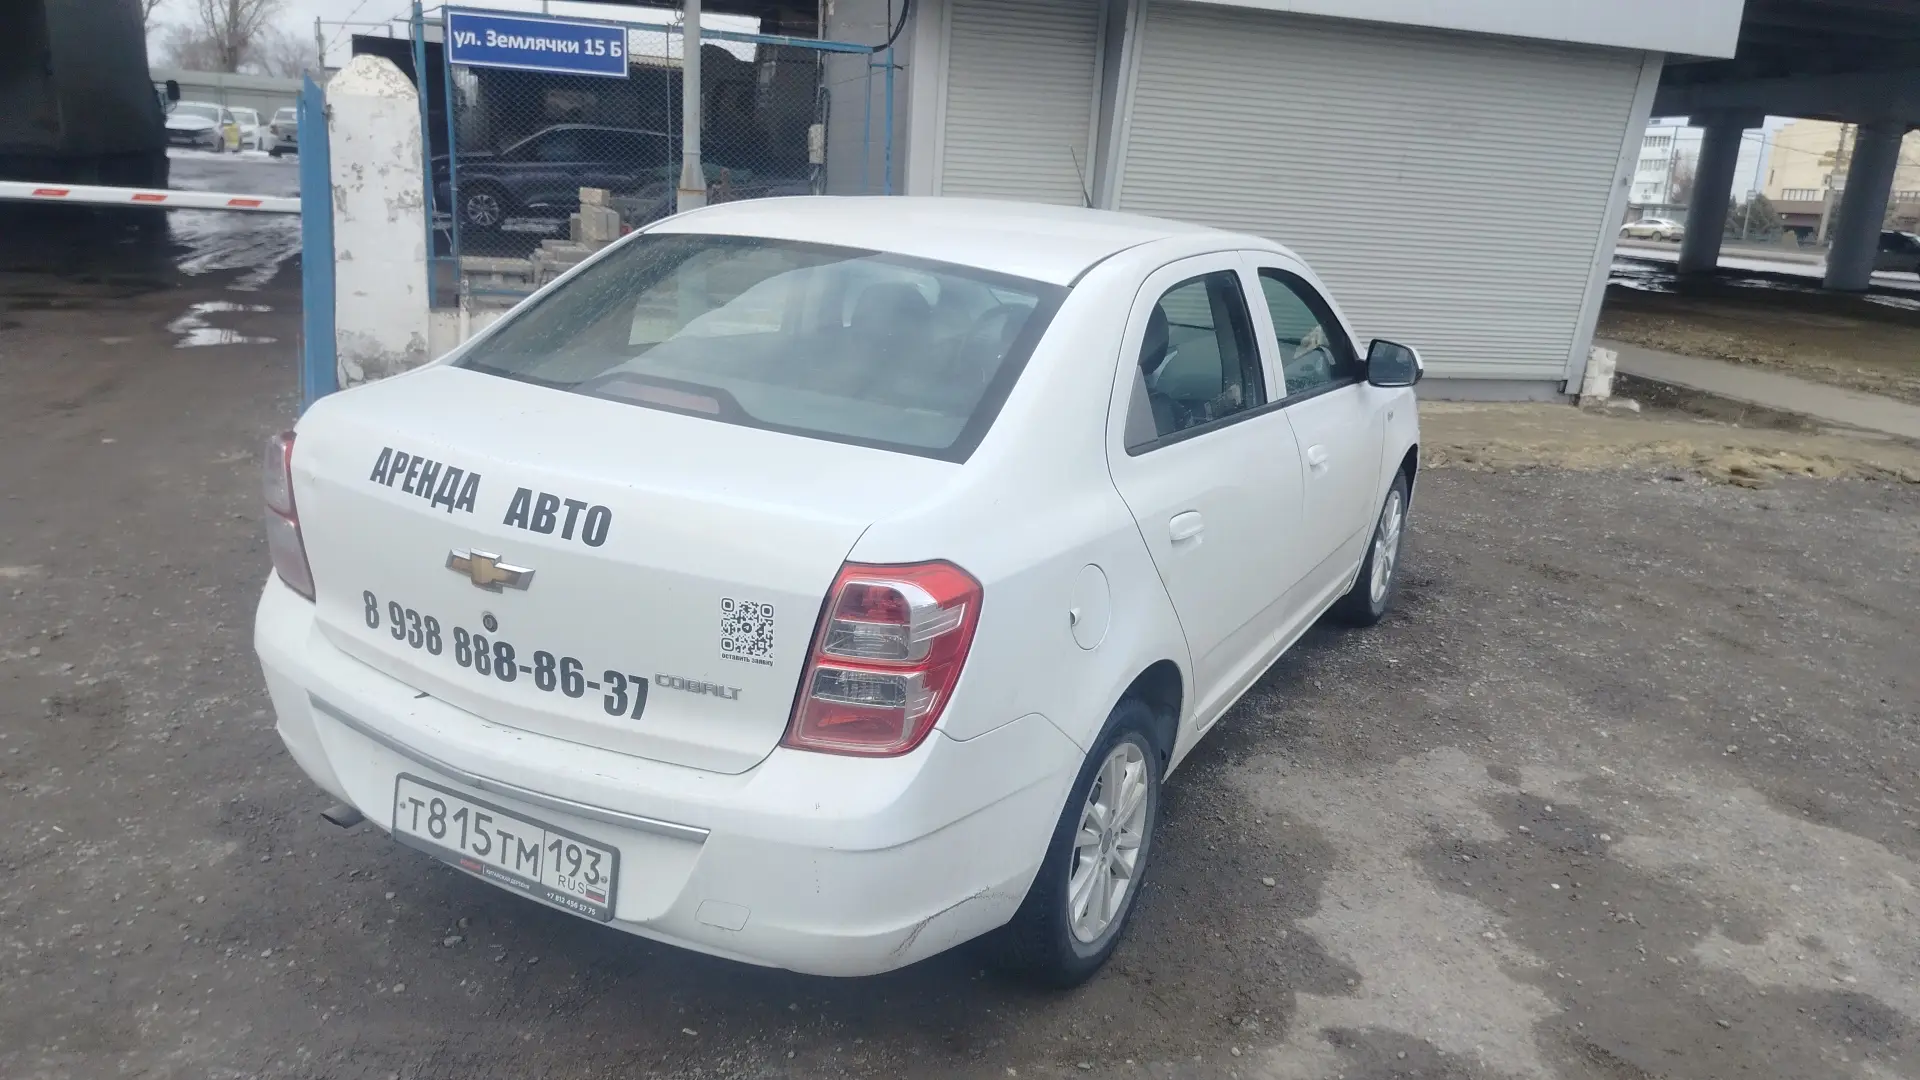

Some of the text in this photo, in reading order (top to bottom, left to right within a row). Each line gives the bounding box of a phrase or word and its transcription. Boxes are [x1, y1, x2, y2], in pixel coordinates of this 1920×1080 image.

[453, 29, 622, 57] ул. Землячки 15 Б
[369, 446, 613, 548] АРЕНДА АВТО
[363, 590, 649, 721] 8 938 888-86-37
[654, 672, 742, 701] COBALT
[548, 838, 602, 885] 193
[557, 874, 585, 894] RUS
